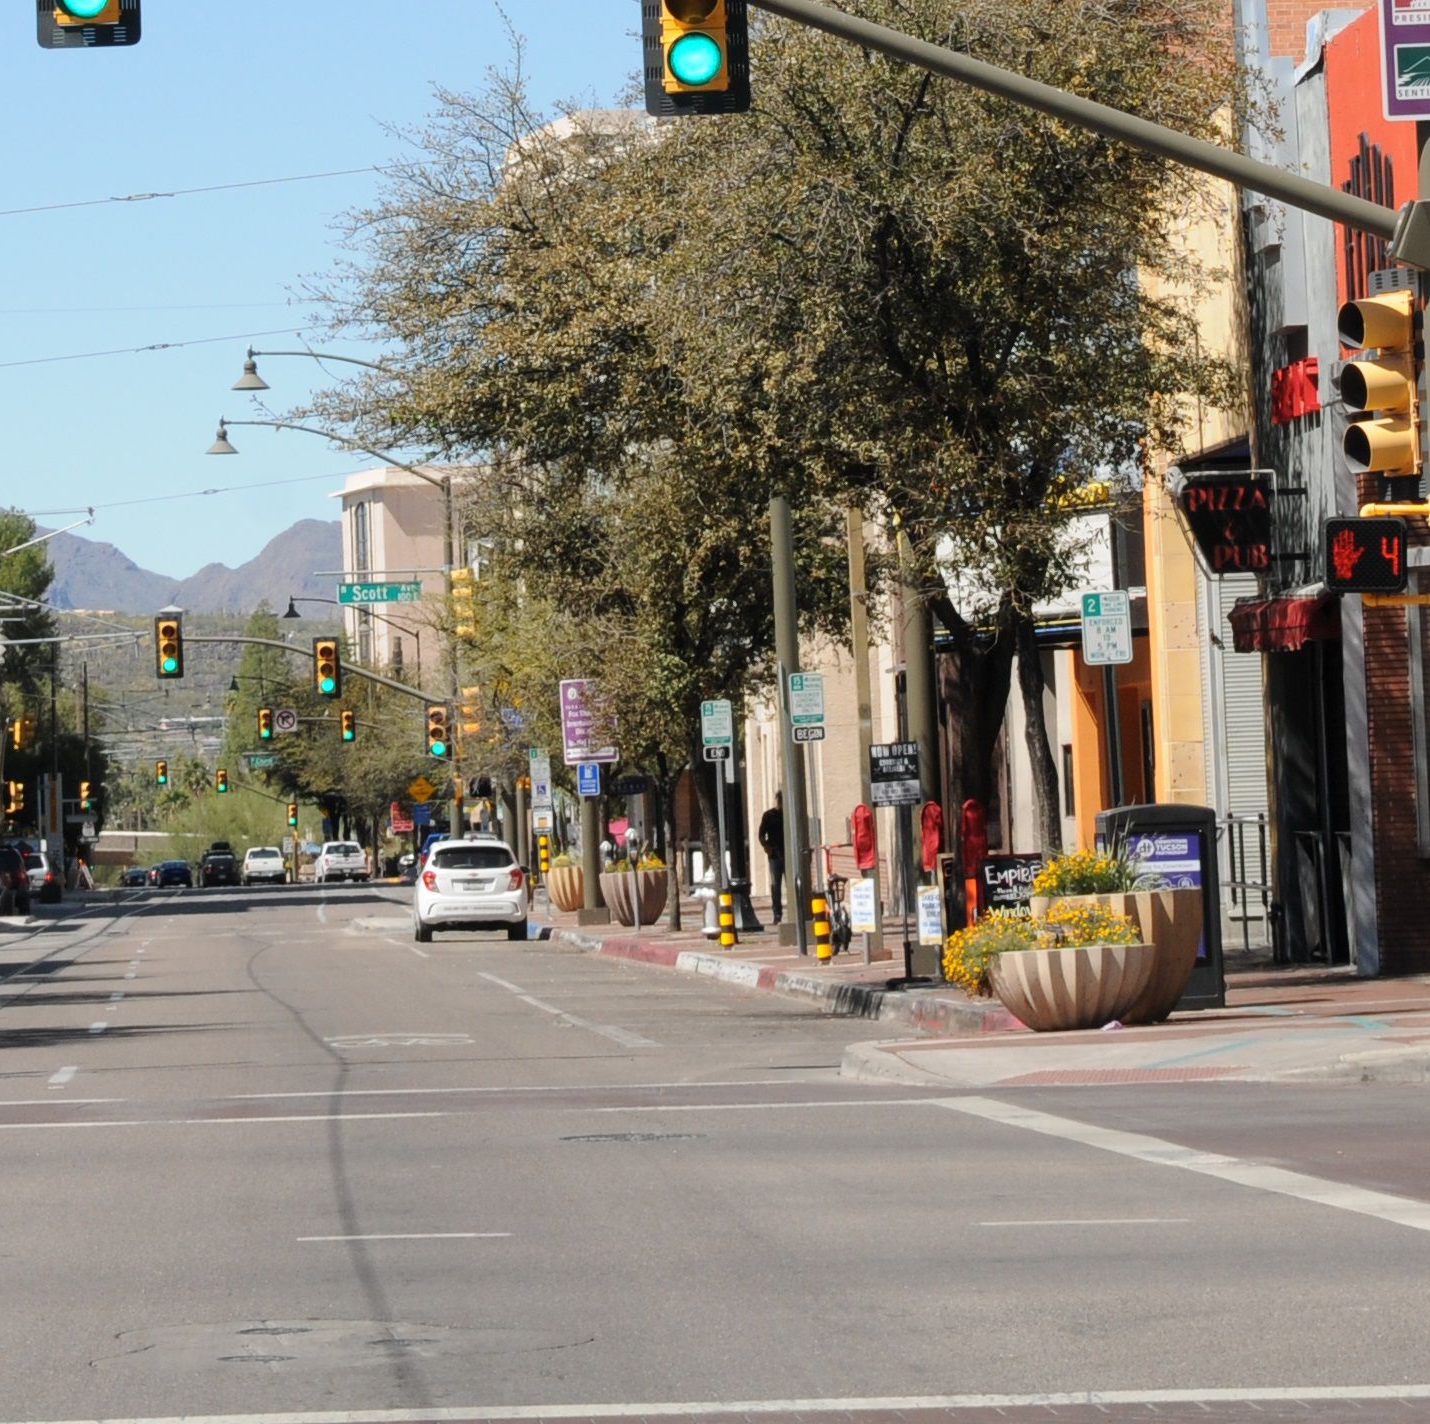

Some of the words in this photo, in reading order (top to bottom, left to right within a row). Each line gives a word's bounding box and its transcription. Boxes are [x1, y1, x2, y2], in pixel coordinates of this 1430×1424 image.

[1188, 486, 1267, 512] PIZZA
[1213, 544, 1269, 570] PUB
[1380, 535, 1400, 577] 4
[352, 585, 388, 601] Scott
[1087, 598, 1096, 613] 2
[1105, 626, 1116, 634] AM
[1106, 642, 1117, 650] PM
[796, 728, 823, 740] BEGIN
[710, 748, 726, 758] END
[871, 746, 890, 758] NOW
[891, 743, 917, 756] OPEN!
[984, 864, 1041, 887] EMPiRE
